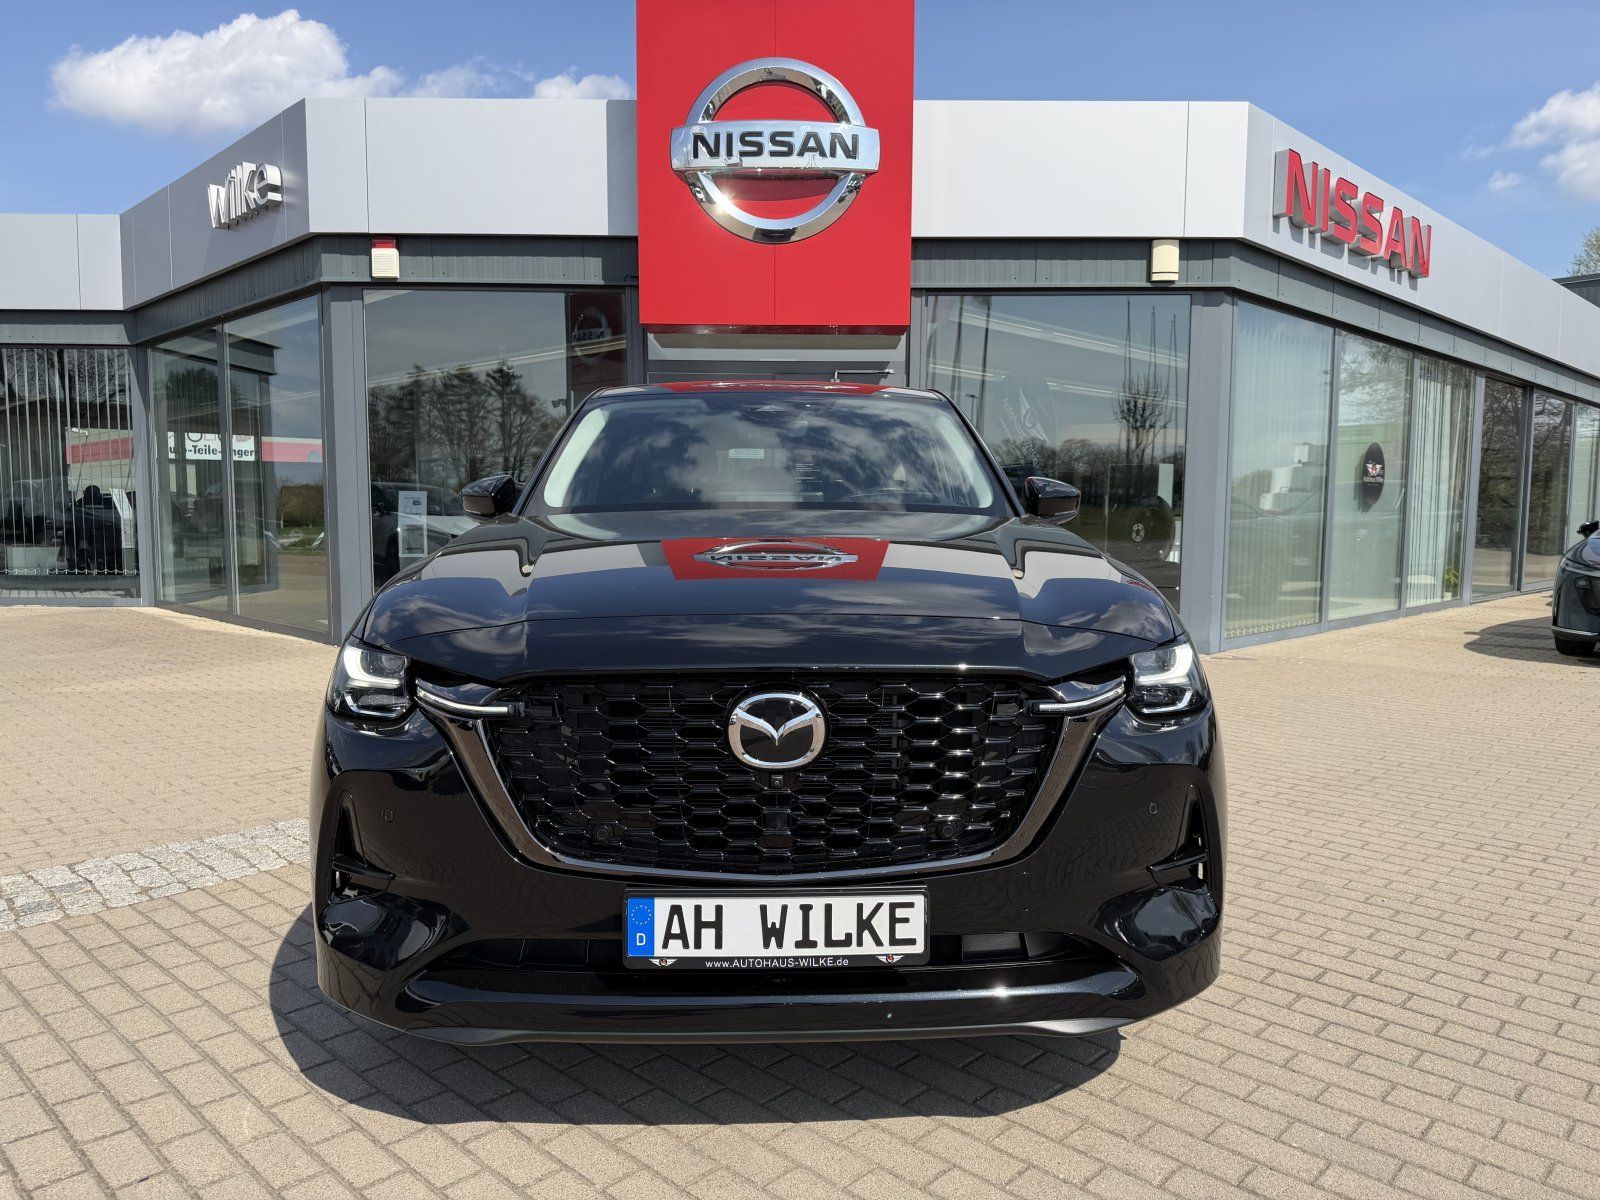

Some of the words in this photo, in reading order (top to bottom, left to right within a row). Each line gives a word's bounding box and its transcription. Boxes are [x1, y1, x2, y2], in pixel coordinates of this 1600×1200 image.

[692, 131, 860, 160] NISSAN
[1274, 147, 1432, 279] NISSAN
[636, 933, 646, 946] D
[661, 904, 724, 950] AH
[759, 901, 917, 950] WILKE
[704, 957, 849, 968] www.AUTOHAUS-WILKE.de
